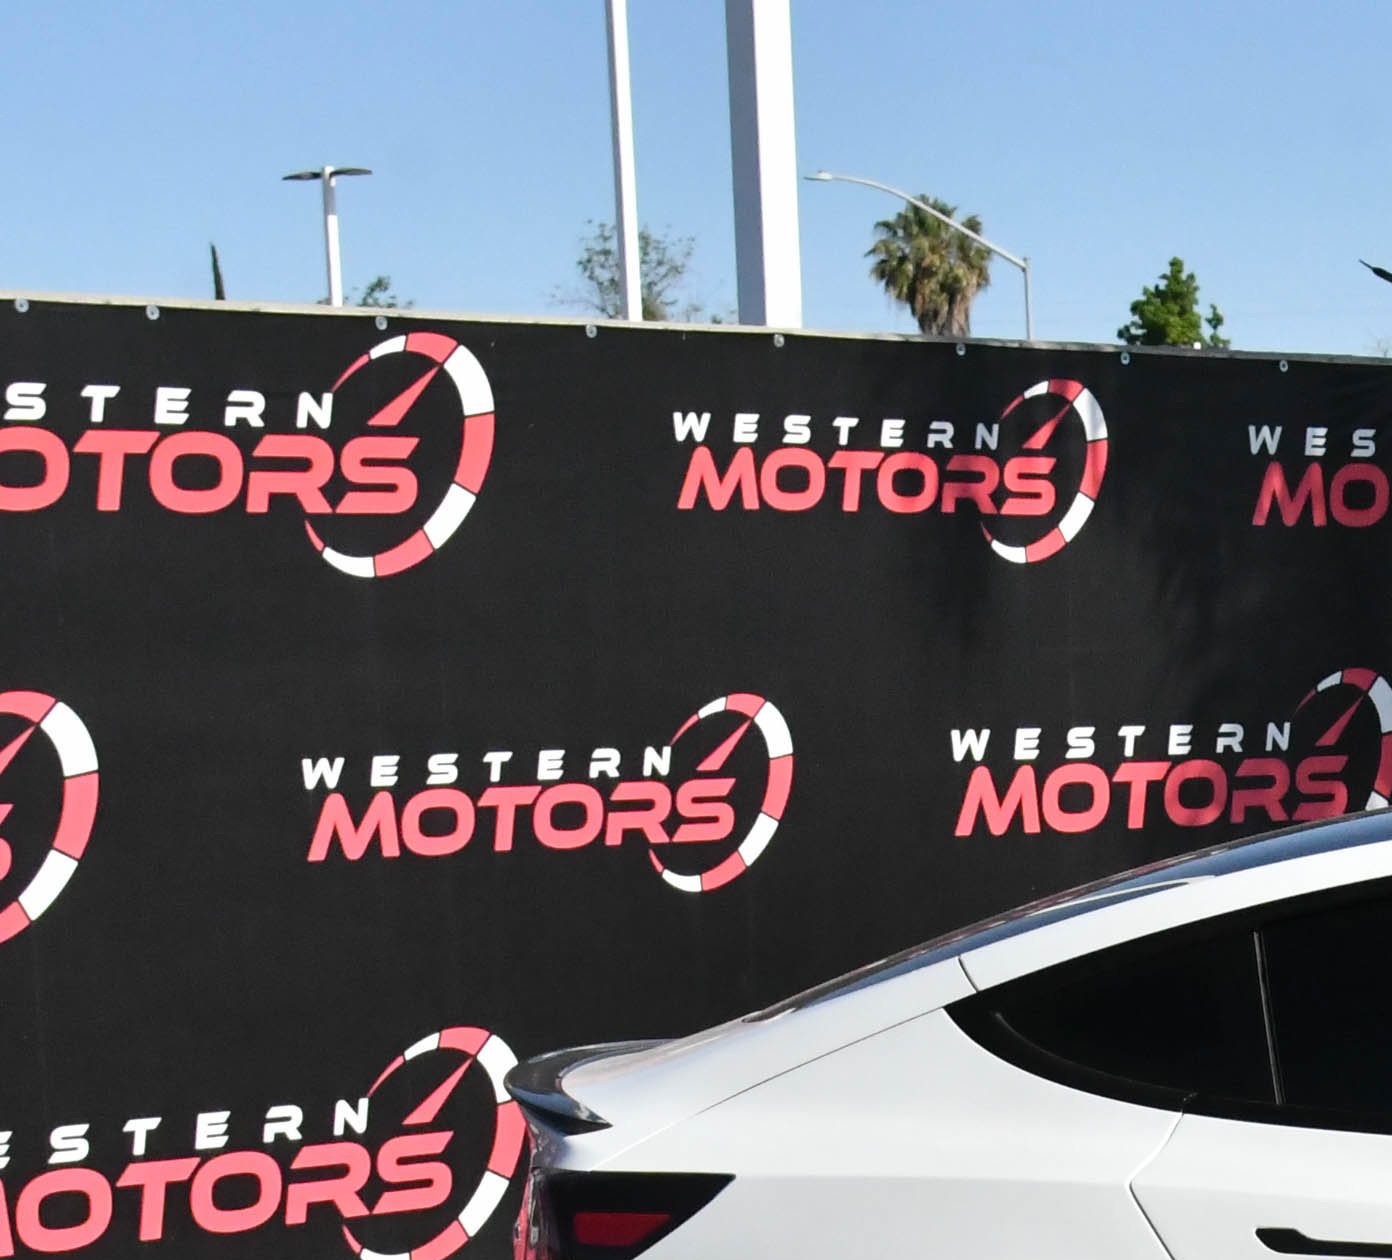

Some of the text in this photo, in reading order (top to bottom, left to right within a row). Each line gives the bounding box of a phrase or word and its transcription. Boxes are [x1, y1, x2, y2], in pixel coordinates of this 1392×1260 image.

[672, 411, 999, 450] WESTERN
[677, 446, 1057, 515] MOTORS
[301, 745, 672, 791] WESTERN
[950, 721, 1291, 762] WESTERN
[307, 777, 736, 862] MOTORS
[954, 755, 1349, 837] MOTORS
[0, 1130, 453, 1257] OTORS
